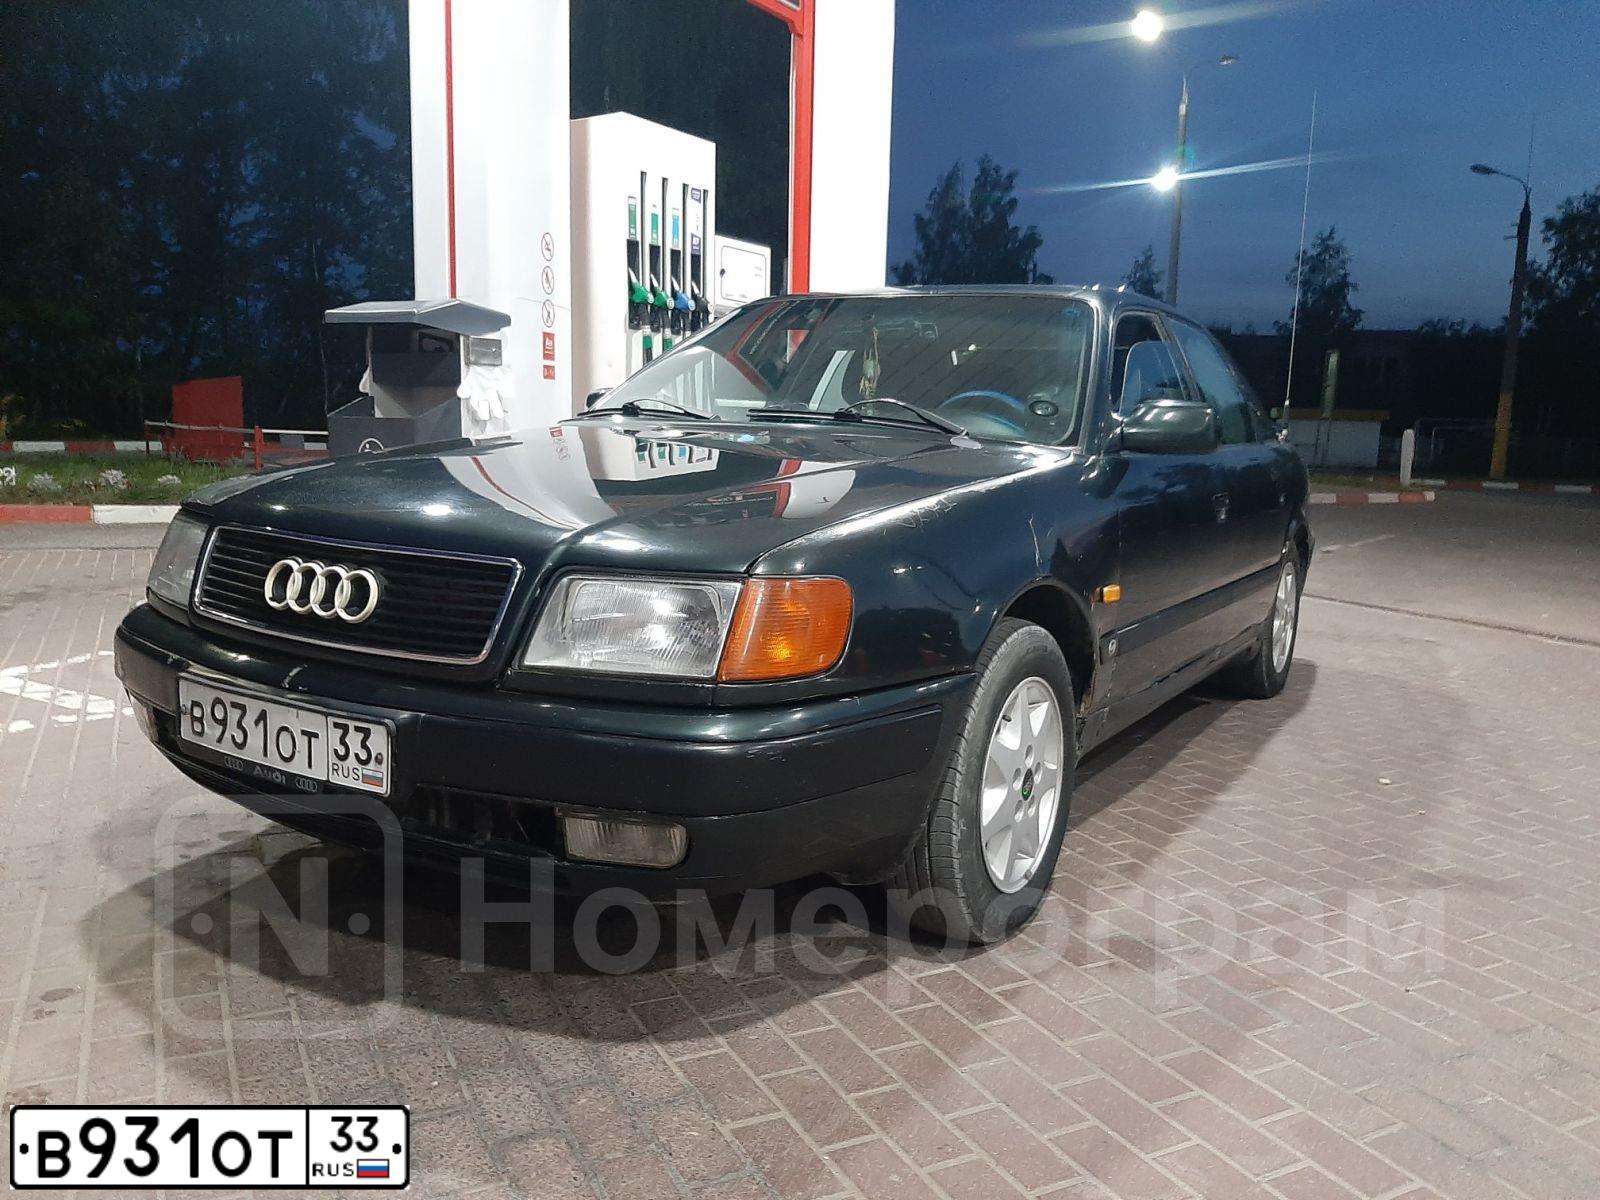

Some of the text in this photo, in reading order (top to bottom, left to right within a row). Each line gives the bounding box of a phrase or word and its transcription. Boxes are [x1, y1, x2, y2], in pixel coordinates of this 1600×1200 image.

[190, 697, 319, 769] В931ОТ
[332, 722, 373, 766] 33
[331, 763, 361, 781] RUS
